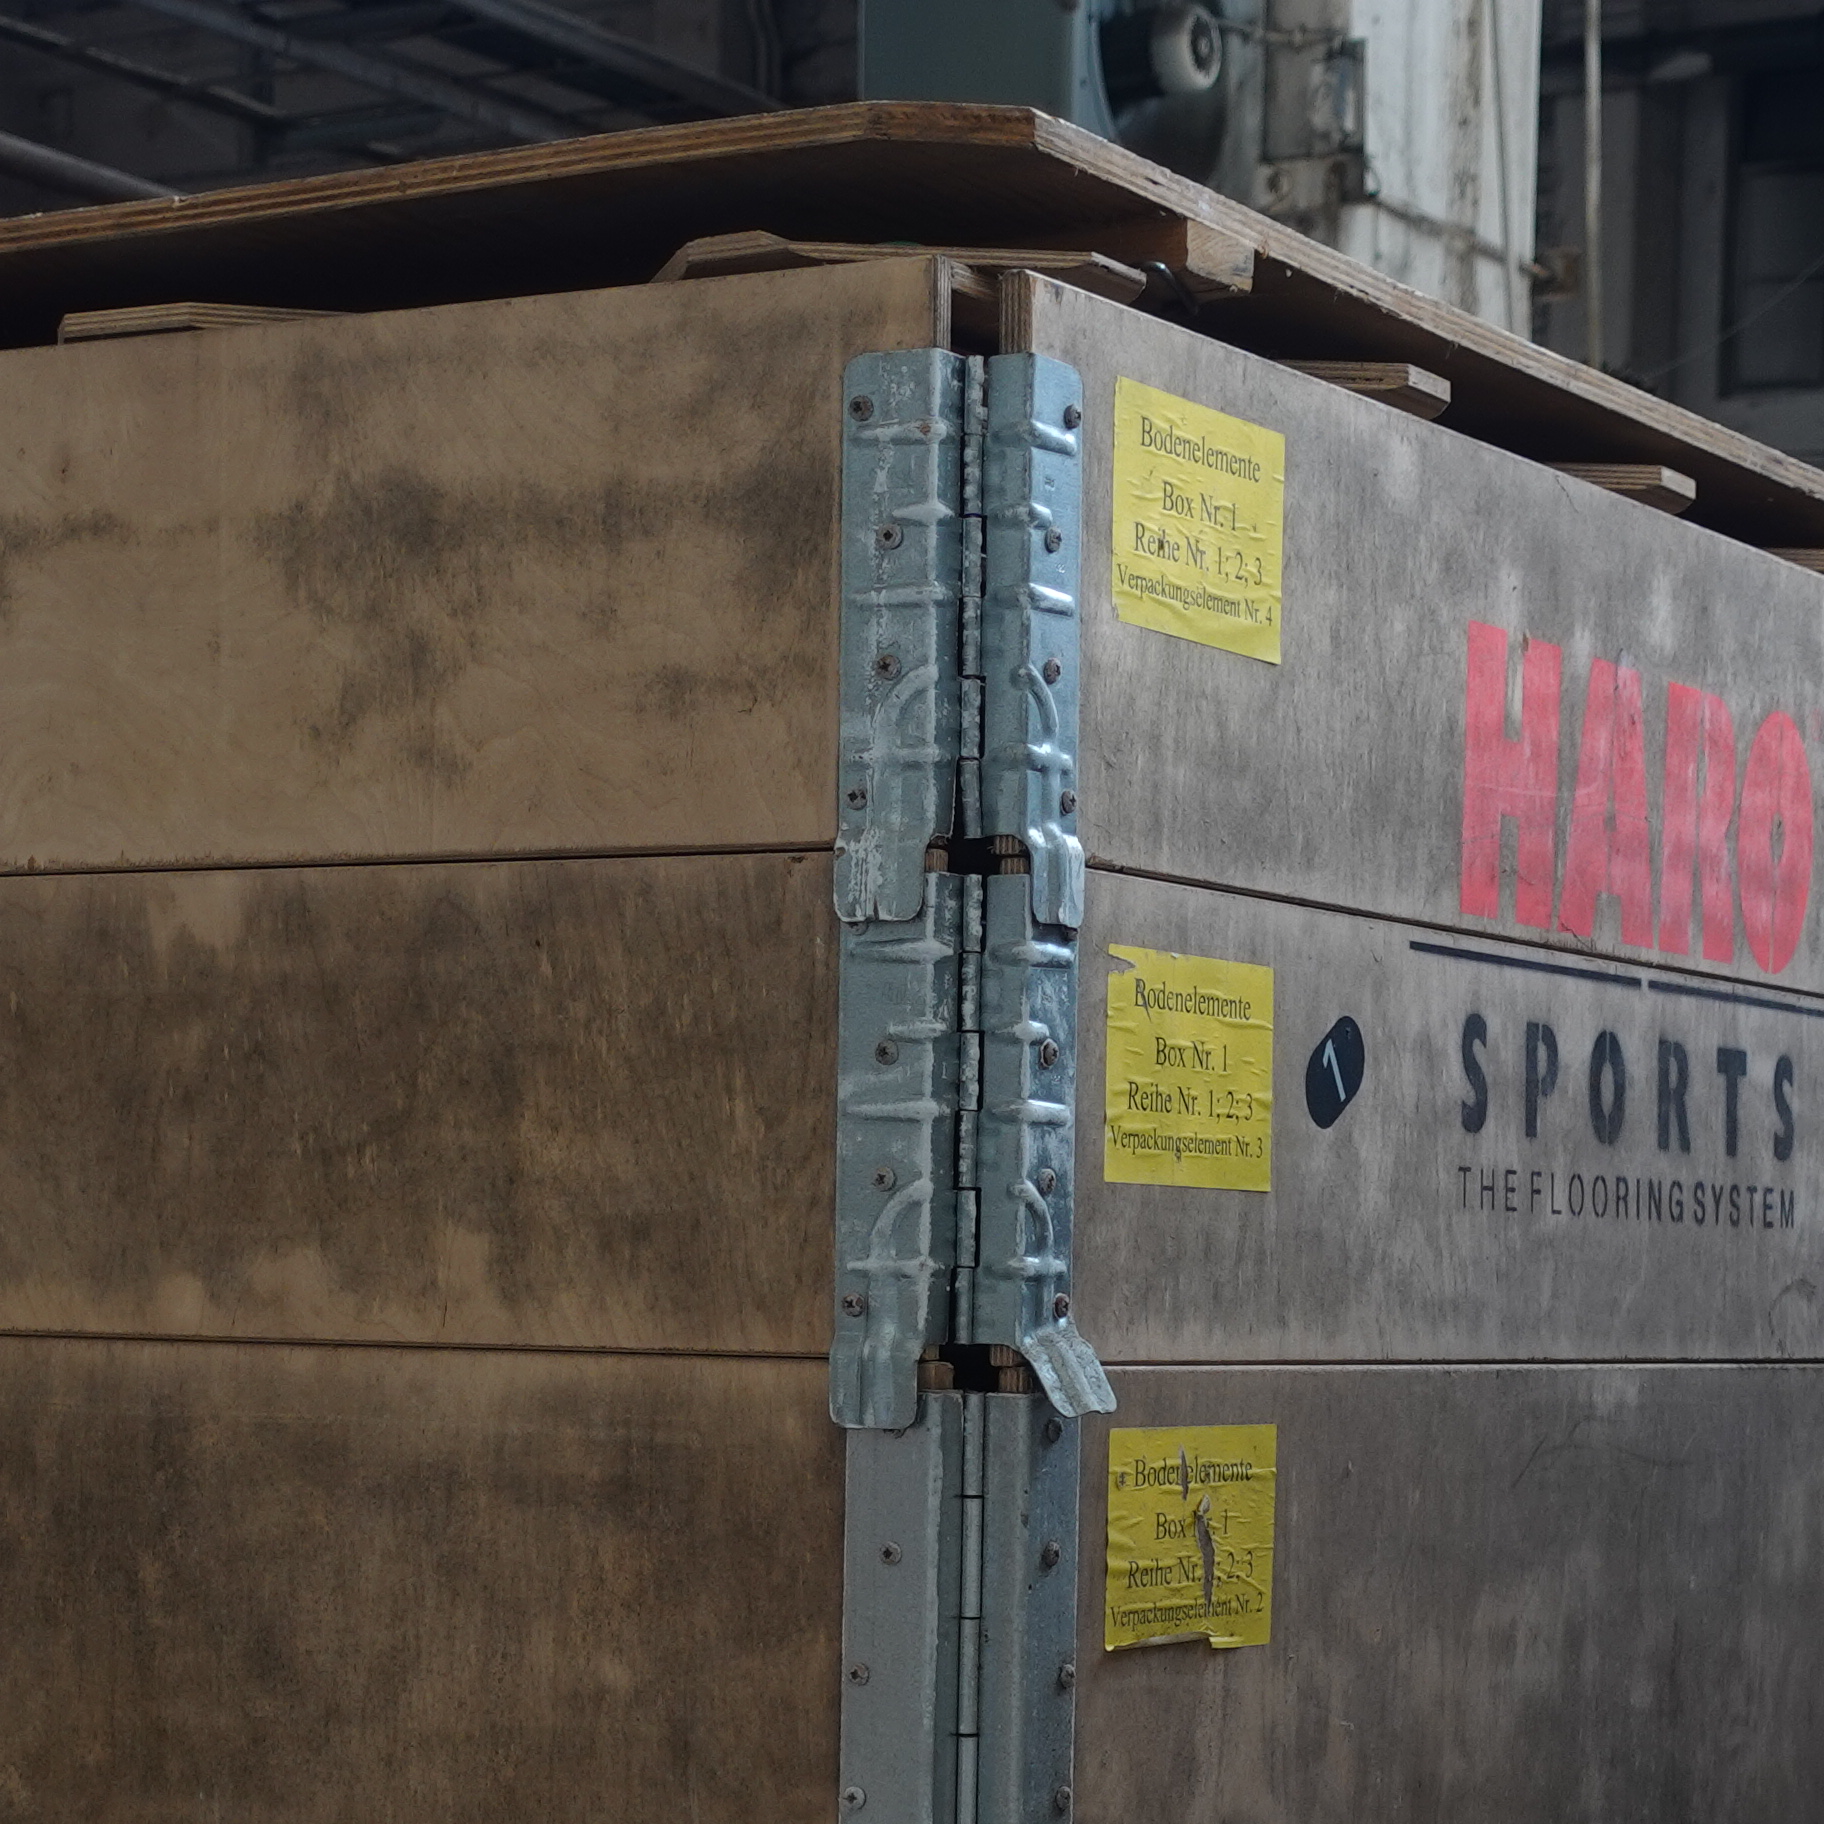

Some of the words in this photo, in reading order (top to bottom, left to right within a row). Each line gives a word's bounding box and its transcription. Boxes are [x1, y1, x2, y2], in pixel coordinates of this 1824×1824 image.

[1141, 416, 1260, 483] Bodenelemente
[1163, 481, 1193, 519] Box
[1200, 493, 1223, 527] Nr.
[1231, 503, 1237, 531] 1
[1134, 521, 1180, 562] Reihe
[1185, 536, 1209, 571] Nr.
[1217, 547, 1229, 584] 1;
[1235, 552, 1249, 588] 2;
[1254, 558, 1262, 585] 3
[1117, 563, 1241, 618] Verpackungselement
[1245, 599, 1262, 624] Nr.
[1265, 606, 1272, 626] 4
[1460, 619, 1814, 975] HARO
[1135, 978, 1251, 1021] Bodenelemente
[1155, 1037, 1186, 1068] Box
[1191, 1041, 1215, 1072] Nr.
[1222, 1045, 1227, 1072] 1
[1127, 1082, 1172, 1114] Reihe
[1177, 1086, 1201, 1116] Nr.
[1208, 1091, 1220, 1122] 1;
[1226, 1091, 1239, 1124] 2;
[1245, 1093, 1253, 1120] 3
[1460, 1012, 1796, 1162] SPORTS
[1110, 1126, 1232, 1157] Verpackungselement
[1235, 1136, 1253, 1157] Nr.
[1256, 1137, 1263, 1158] 3
[1457, 1165, 1518, 1213] THE
[1154, 1512, 1186, 1540] Box
[1223, 1509, 1228, 1535] 1
[1127, 1560, 1172, 1588] Reihe
[1177, 1555, 1201, 1585] Nr.
[1227, 1551, 1240, 1582] 2;
[1246, 1551, 1253, 1578] 3
[1235, 1594, 1252, 1615] Nr.
[1256, 1592, 1264, 1613] 2
